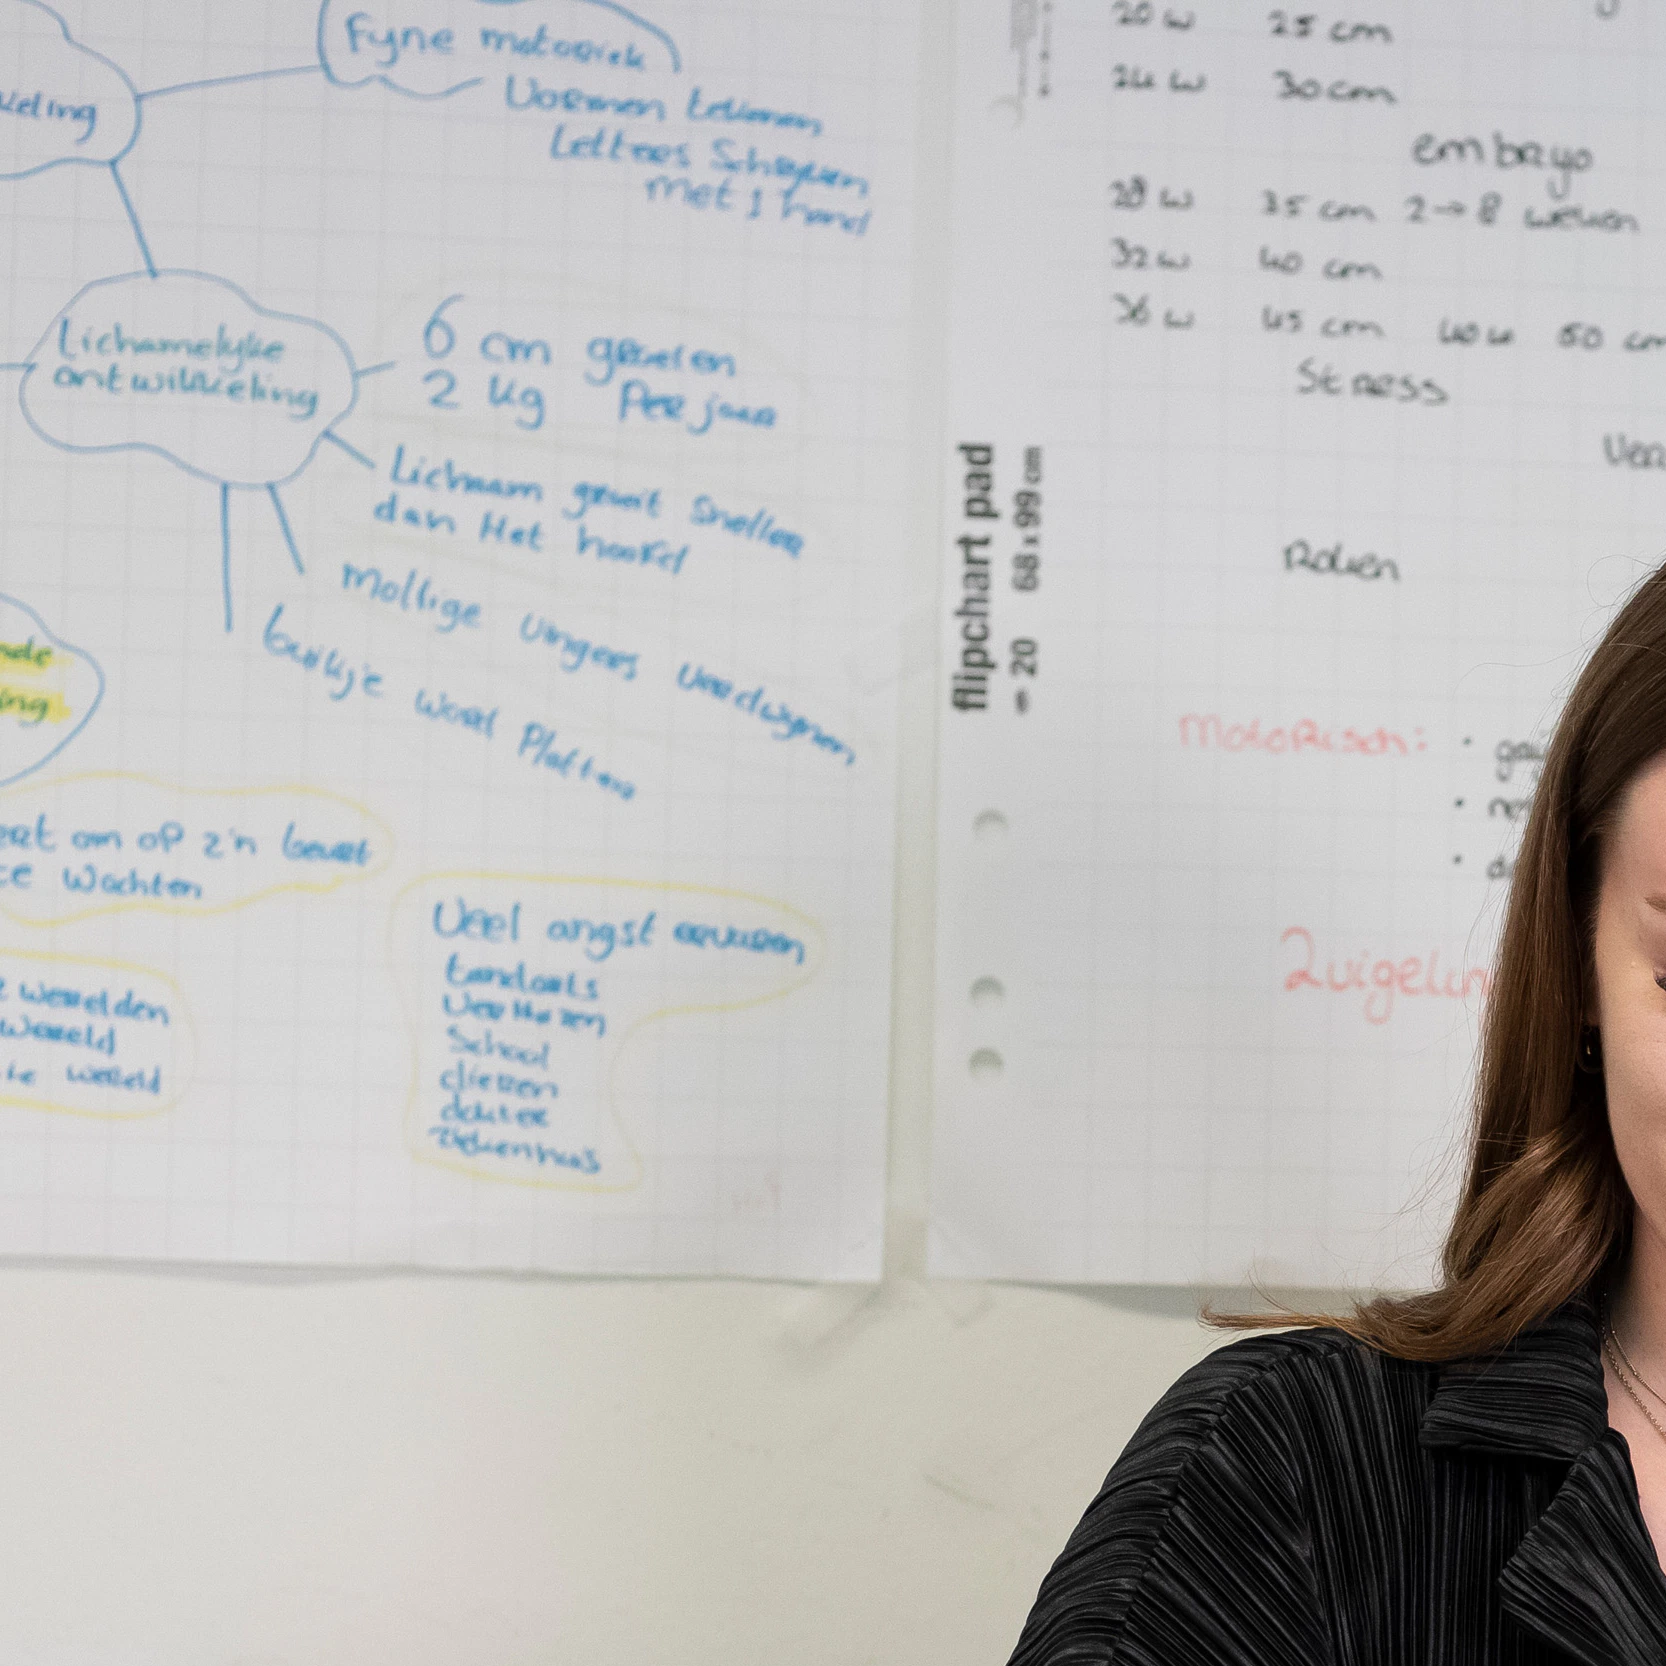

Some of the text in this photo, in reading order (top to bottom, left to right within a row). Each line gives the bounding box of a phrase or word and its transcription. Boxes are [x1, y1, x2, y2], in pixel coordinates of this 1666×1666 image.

[422, 294, 463, 360] 6
[479, 332, 552, 366] cm
[422, 368, 459, 410] 2
[950, 442, 1002, 714] flipchart pad
[1008, 637, 1039, 678] 20
